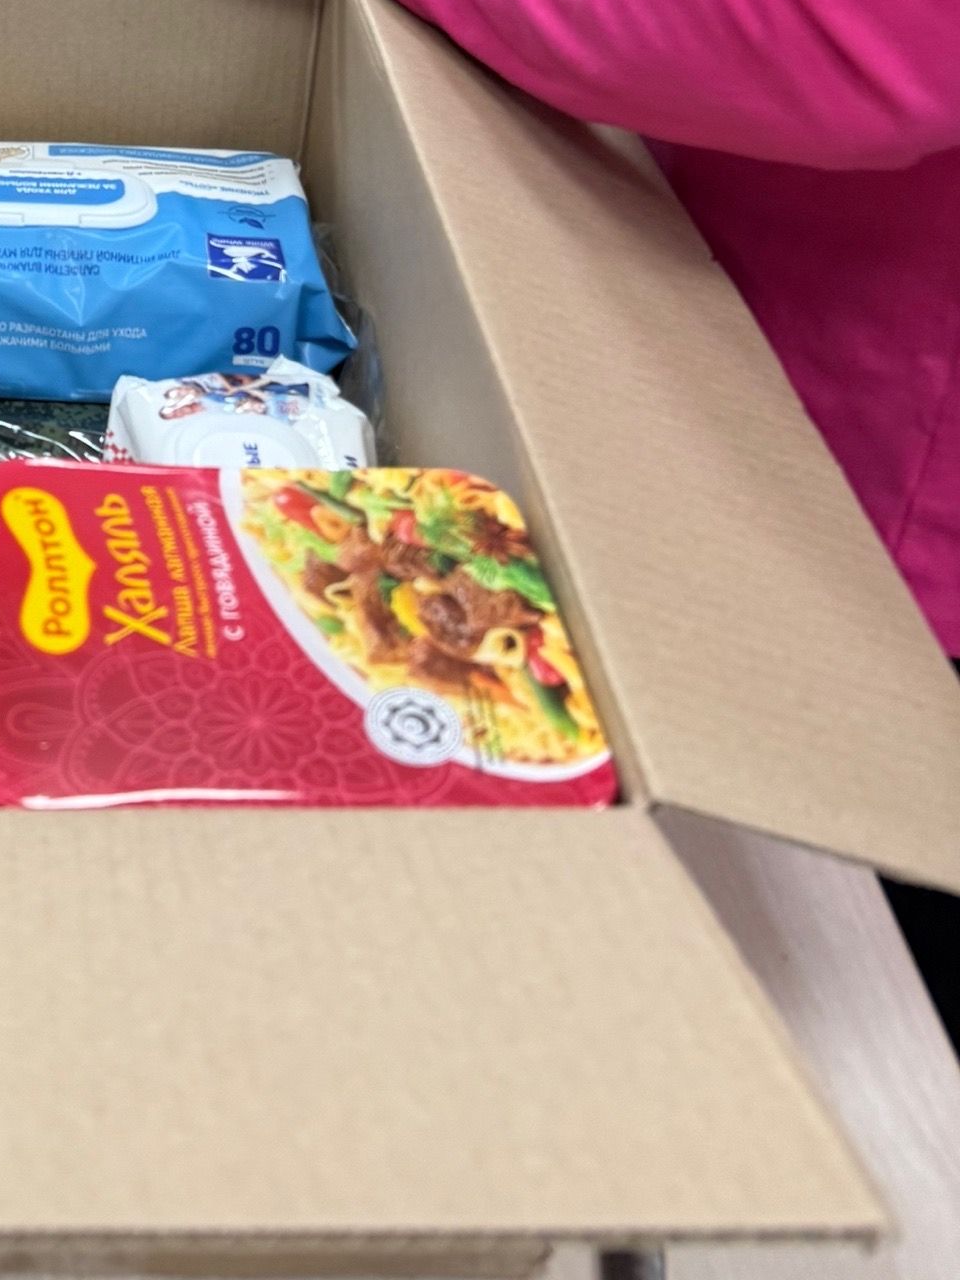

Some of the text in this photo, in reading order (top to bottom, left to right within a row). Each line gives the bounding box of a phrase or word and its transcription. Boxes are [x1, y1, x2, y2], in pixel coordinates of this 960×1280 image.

[20, 246, 43, 259] ДЛЯ
[8, 321, 86, 342] РАЗРАБОТАНЫ
[112, 327, 148, 339] УХОДА
[232, 326, 281, 358] 80
[50, 341, 112, 355] БОЛЬНЫМИ
[23, 497, 71, 638] Роллтон
[93, 493, 173, 646] Халяль
[172, 585, 198, 658] Лапша
